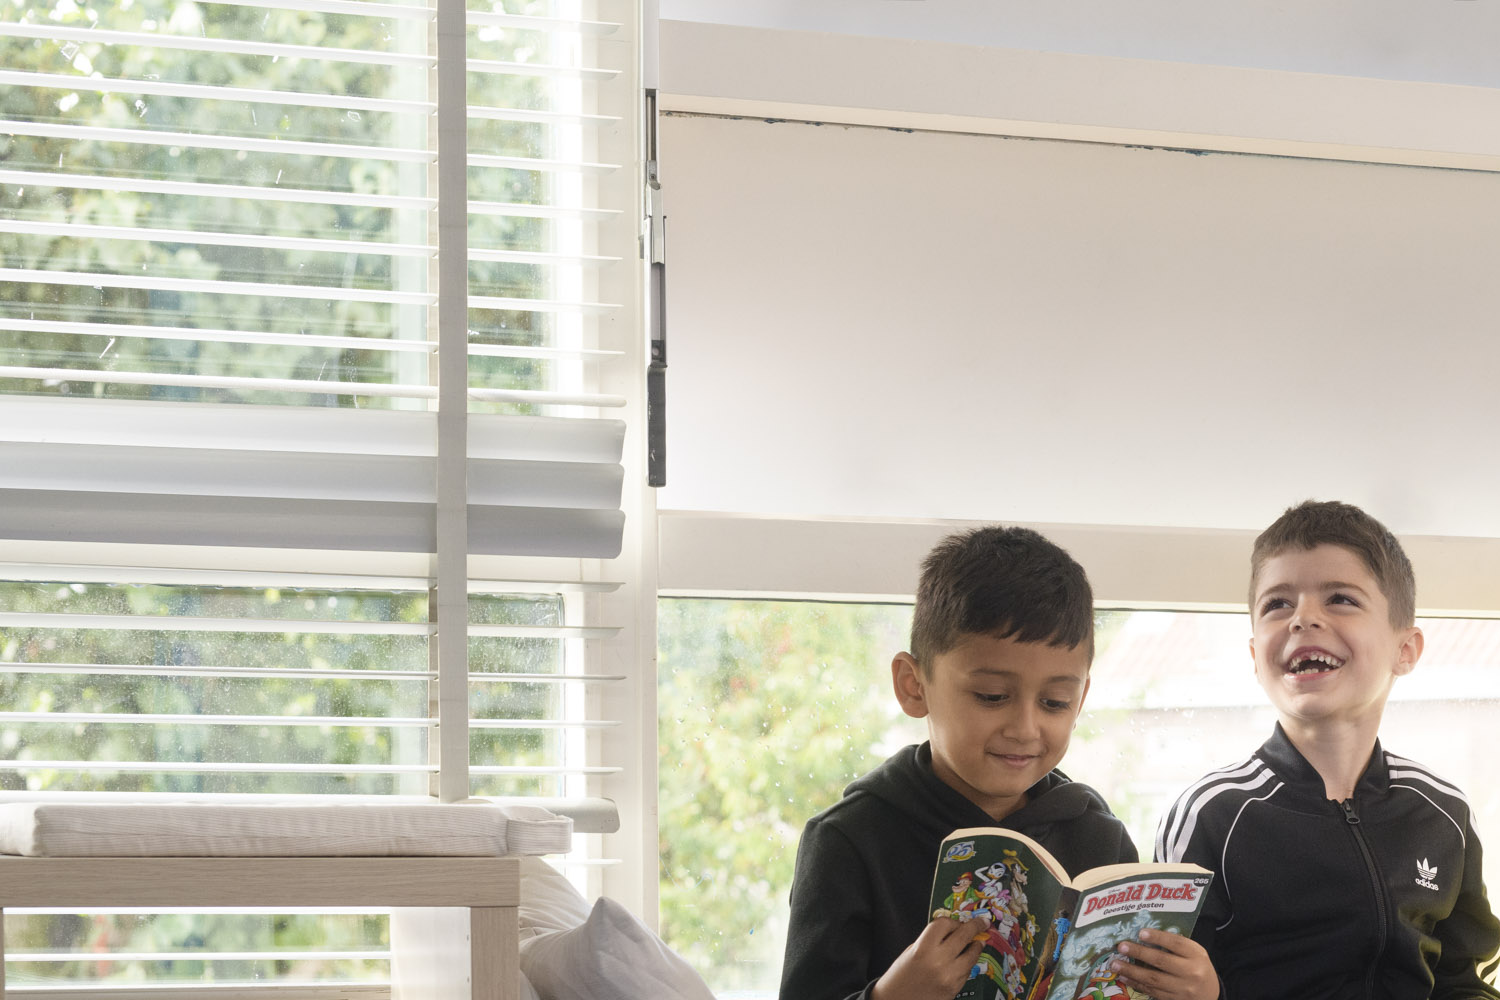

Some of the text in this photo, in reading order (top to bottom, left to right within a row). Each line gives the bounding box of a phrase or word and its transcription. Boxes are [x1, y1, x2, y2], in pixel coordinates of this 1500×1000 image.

[1415, 877, 1440, 891] adidas
[1084, 883, 1198, 916] Donald Duck
[1103, 902, 1165, 916] Geestige gasten
